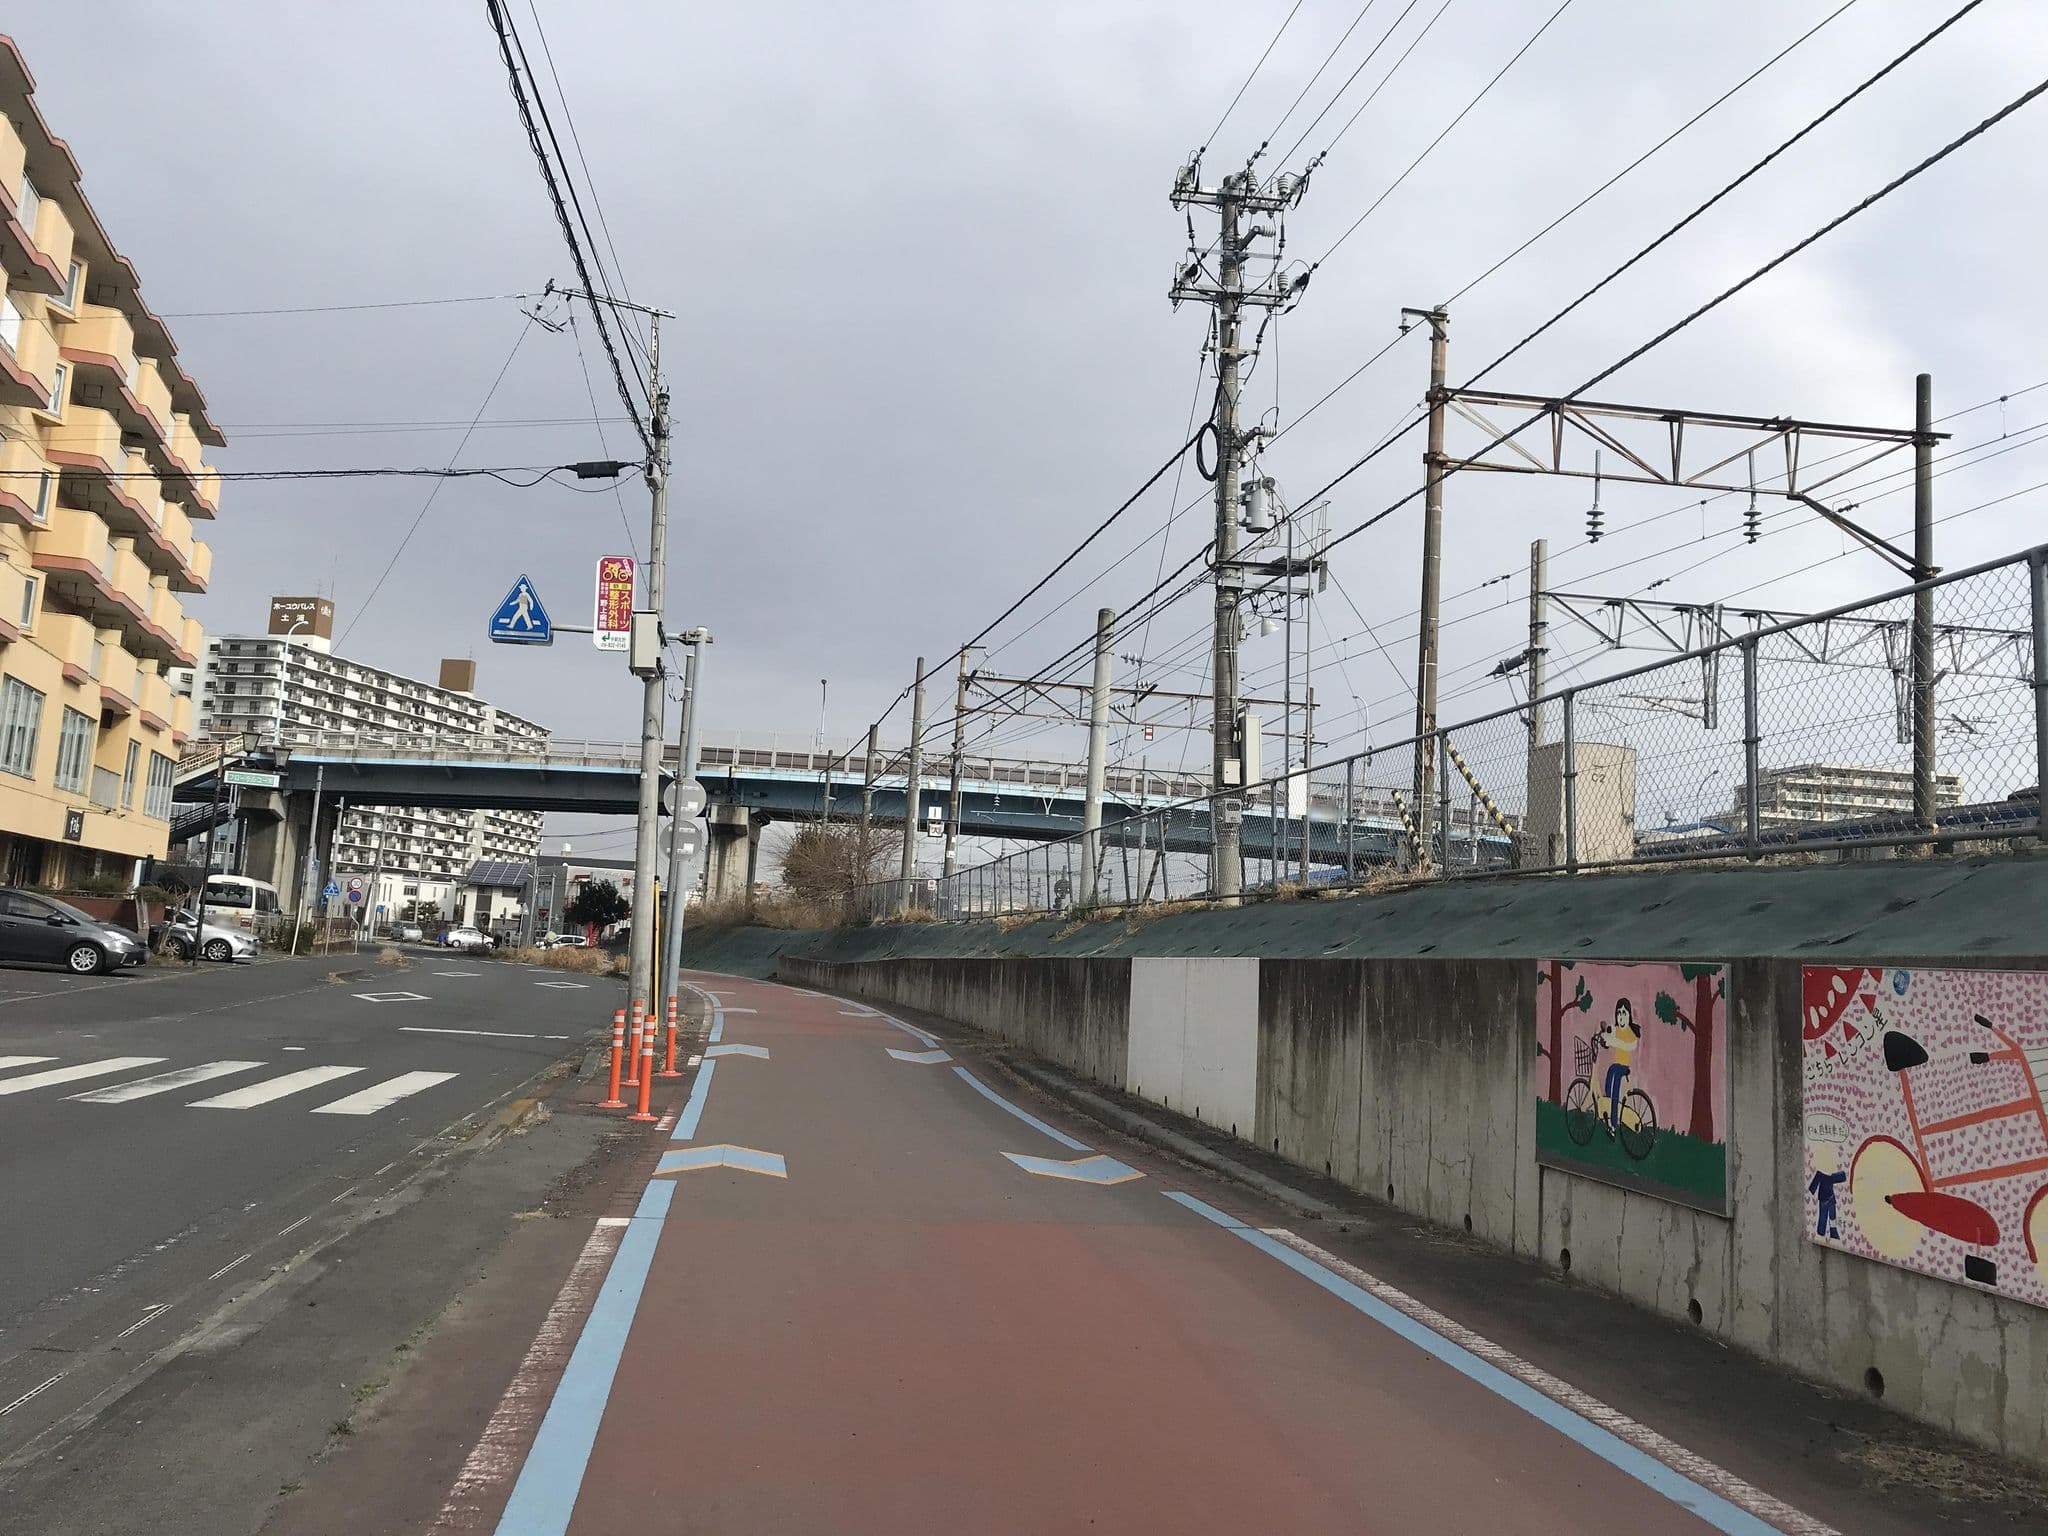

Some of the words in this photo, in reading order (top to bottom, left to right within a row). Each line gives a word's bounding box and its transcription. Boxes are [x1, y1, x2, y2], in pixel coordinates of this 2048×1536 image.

[608, 591, 620, 630] 整形外科
[620, 591, 631, 630] スポーツ
